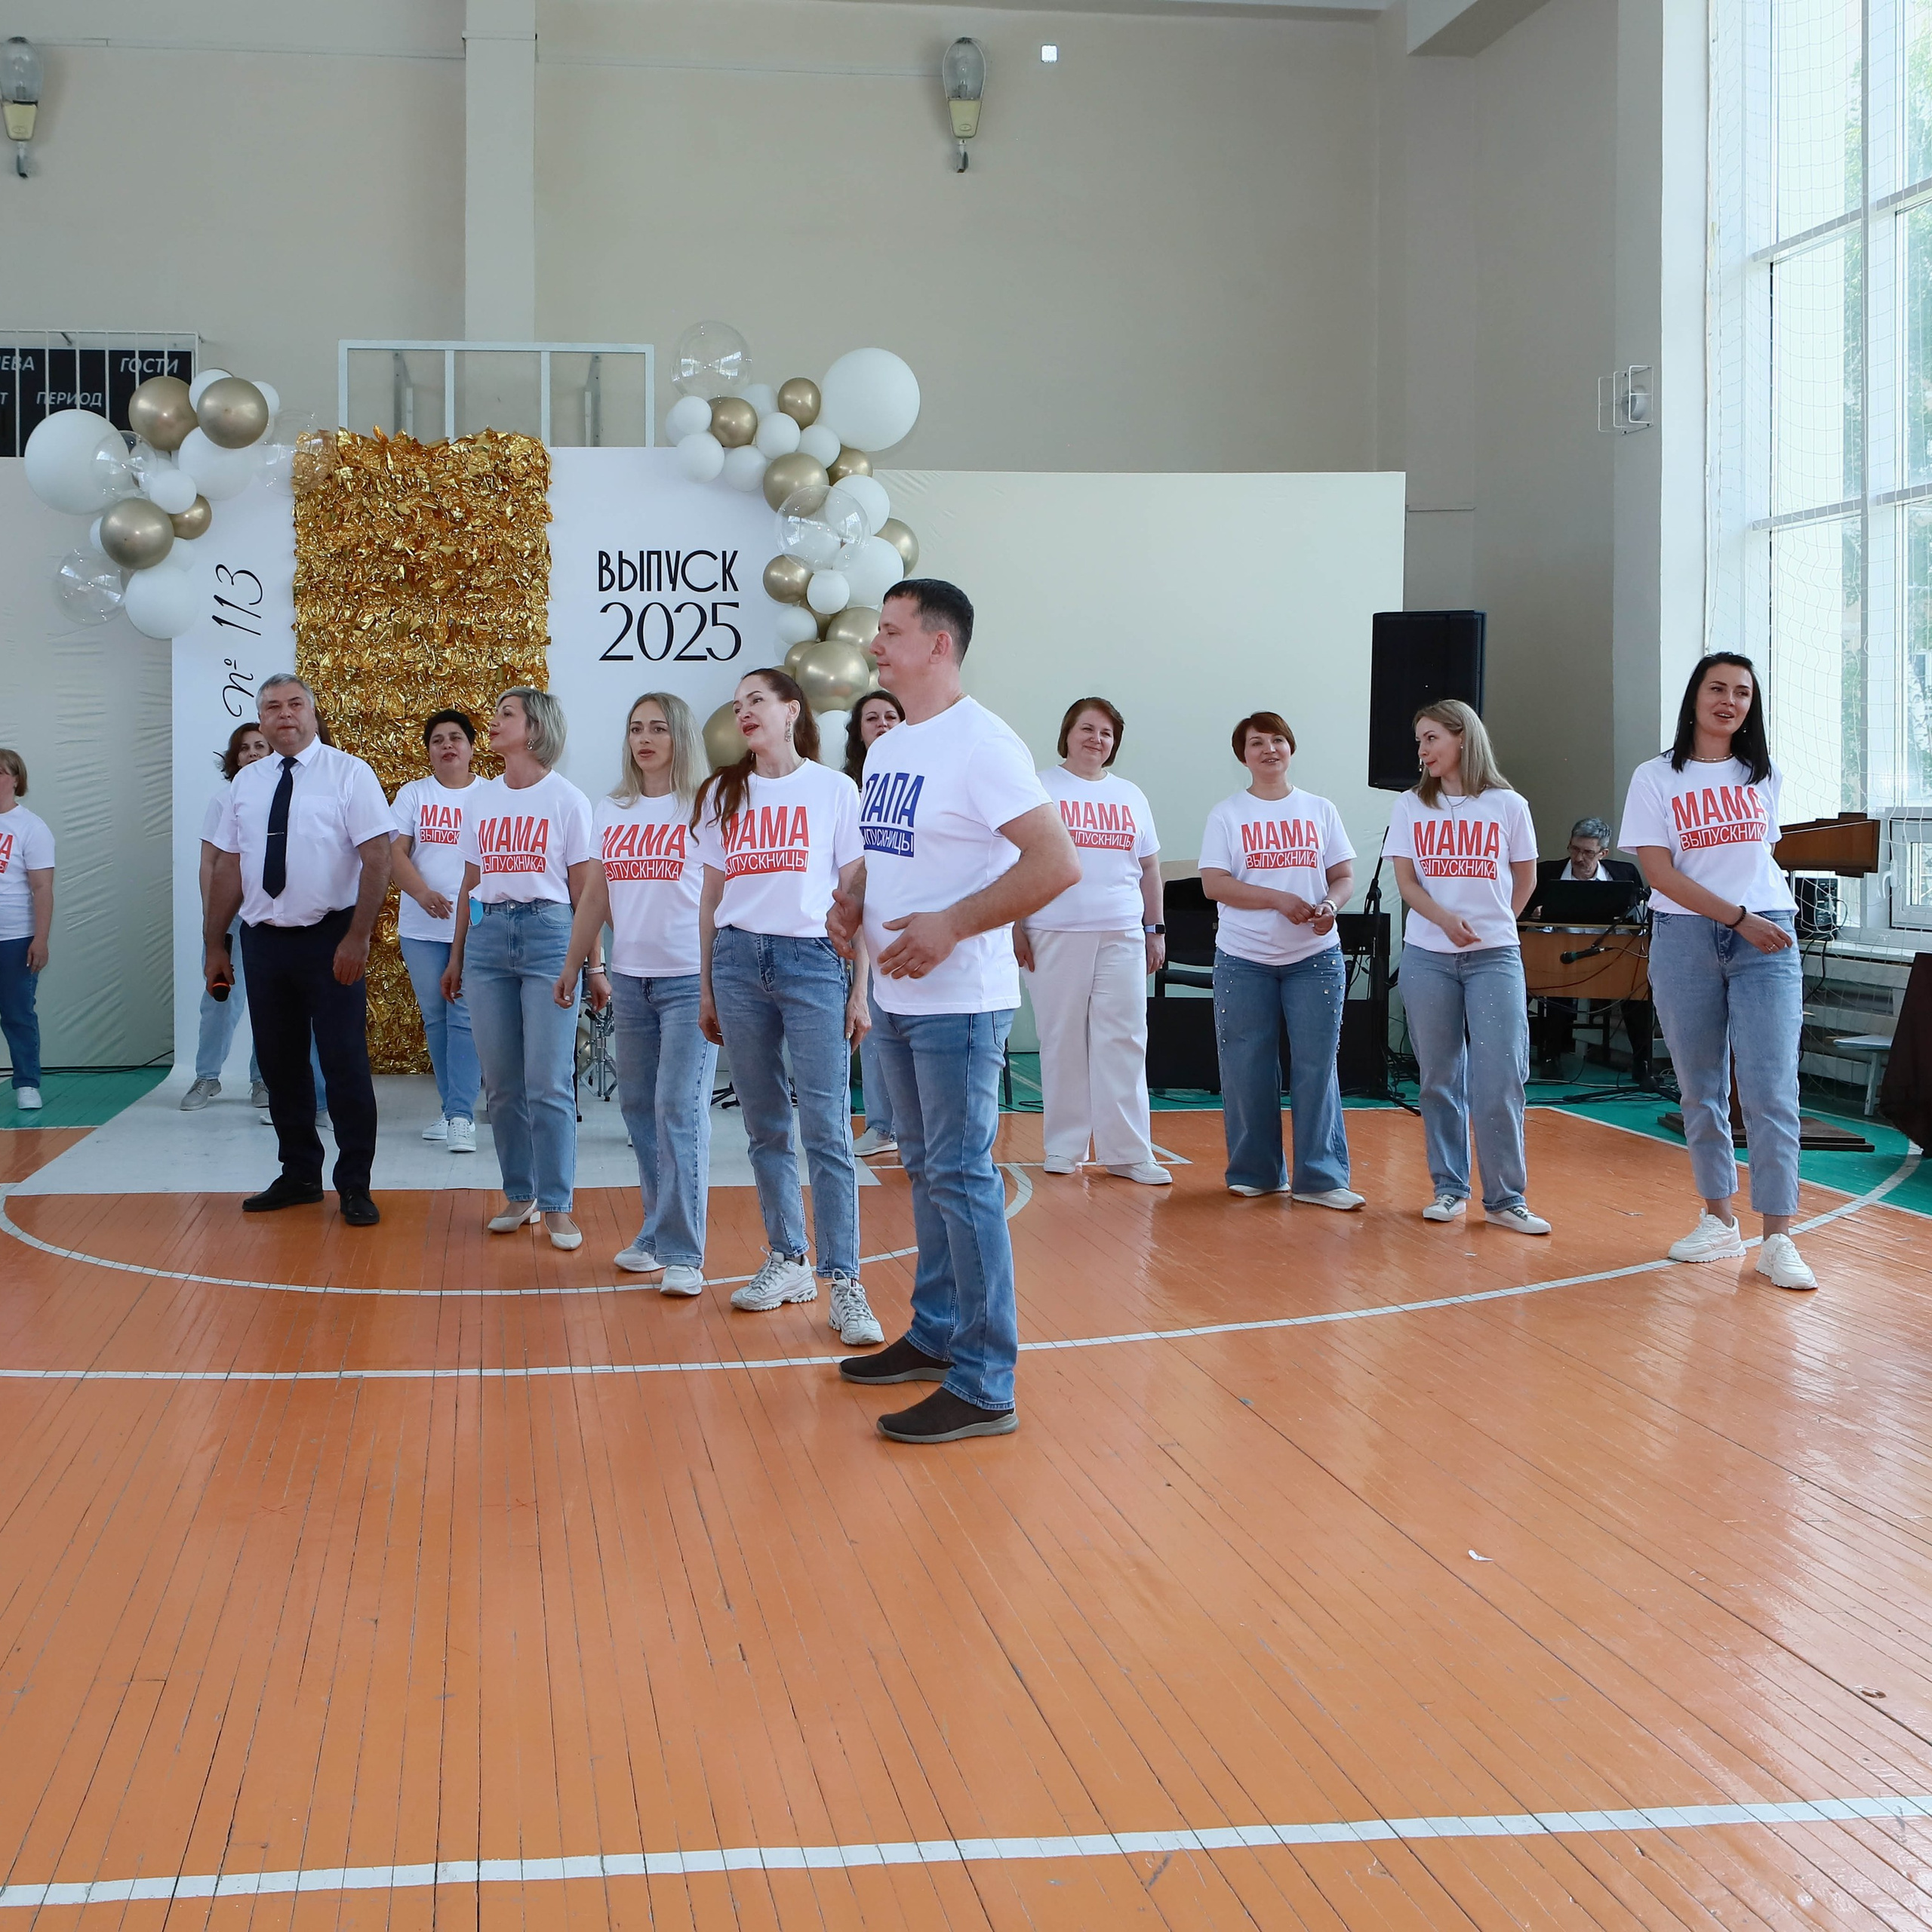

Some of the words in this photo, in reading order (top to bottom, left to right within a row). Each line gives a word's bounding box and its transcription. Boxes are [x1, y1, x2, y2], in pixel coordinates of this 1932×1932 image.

[0, 355, 35, 371] ЕВА
[120, 358, 179, 374] ГОСТИ
[36, 392, 103, 408] ПЕРИОД
[598, 549, 740, 592] ВЫПУСК
[211, 564, 263, 636] 113
[598, 601, 743, 661] 2025
[860, 772, 925, 829] ПАПА
[1060, 800, 1137, 834] МАМА
[1672, 786, 1767, 832] МАМА
[478, 816, 549, 854] МАМА
[601, 823, 687, 860] МАМА
[1241, 819, 1319, 854] МАМА
[1414, 820, 1500, 859] МАМА
[603, 860, 680, 880] ЫПУСКНИКА
[725, 851, 808, 878] ЫПУСКНИЦЫ
[1246, 851, 1317, 868] ВЫПУСКНИКА
